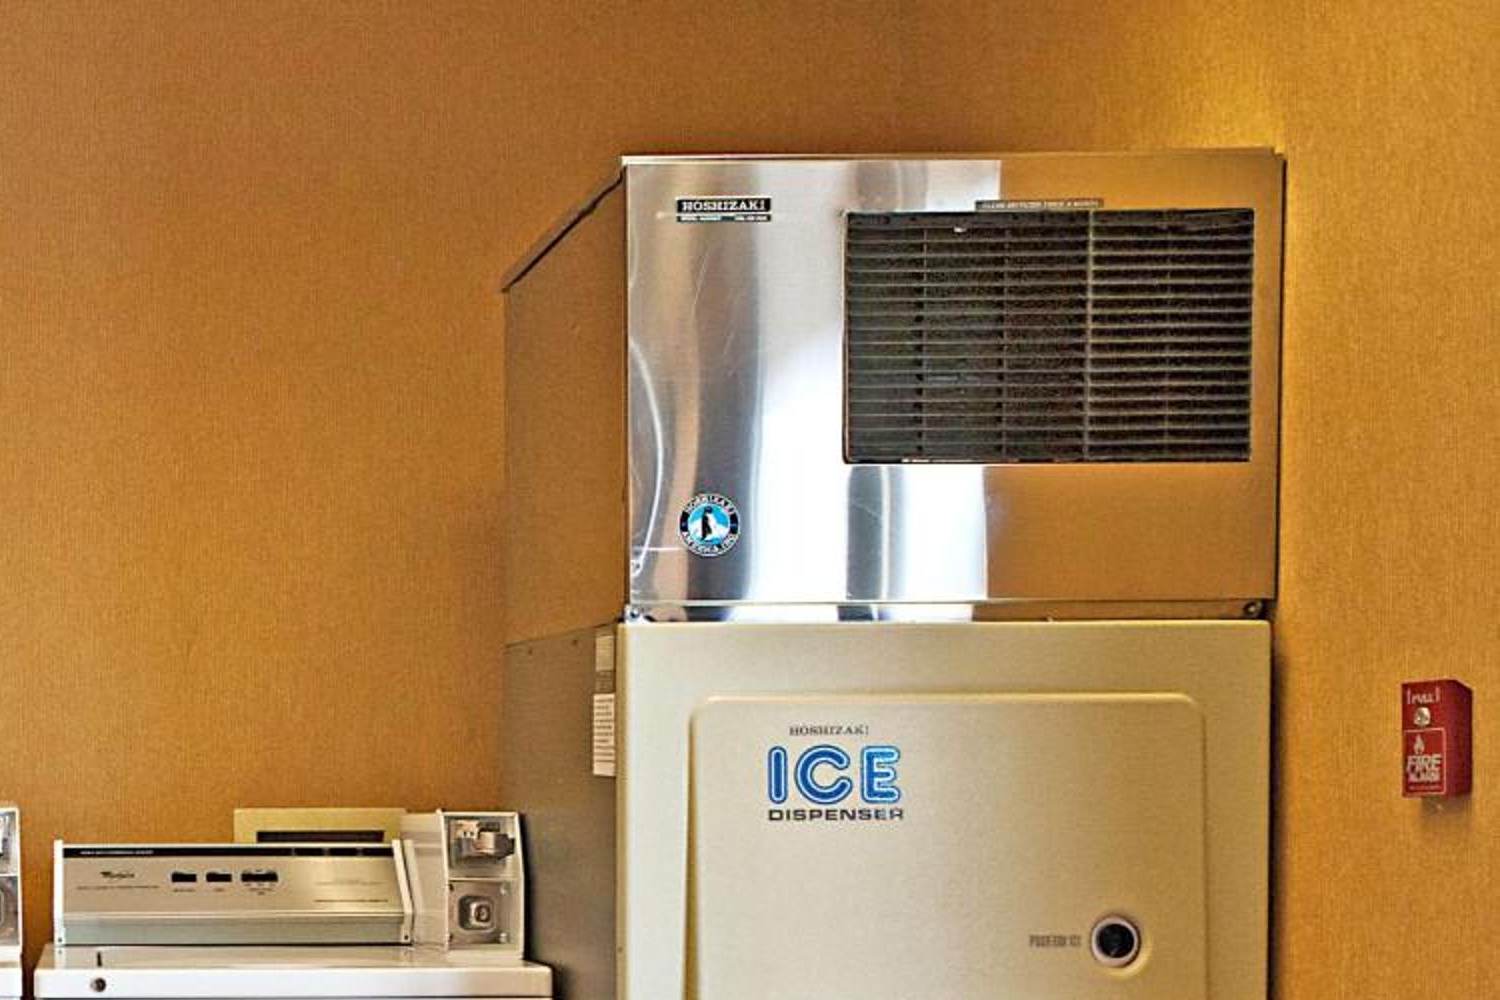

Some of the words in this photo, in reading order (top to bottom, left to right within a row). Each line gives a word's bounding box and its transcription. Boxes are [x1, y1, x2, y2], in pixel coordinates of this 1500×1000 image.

[681, 200, 766, 212] HOSHIZAKI
[789, 724, 869, 737] HOSHIZAKI
[768, 744, 901, 805] ICE
[768, 809, 904, 822] DISPENSER
